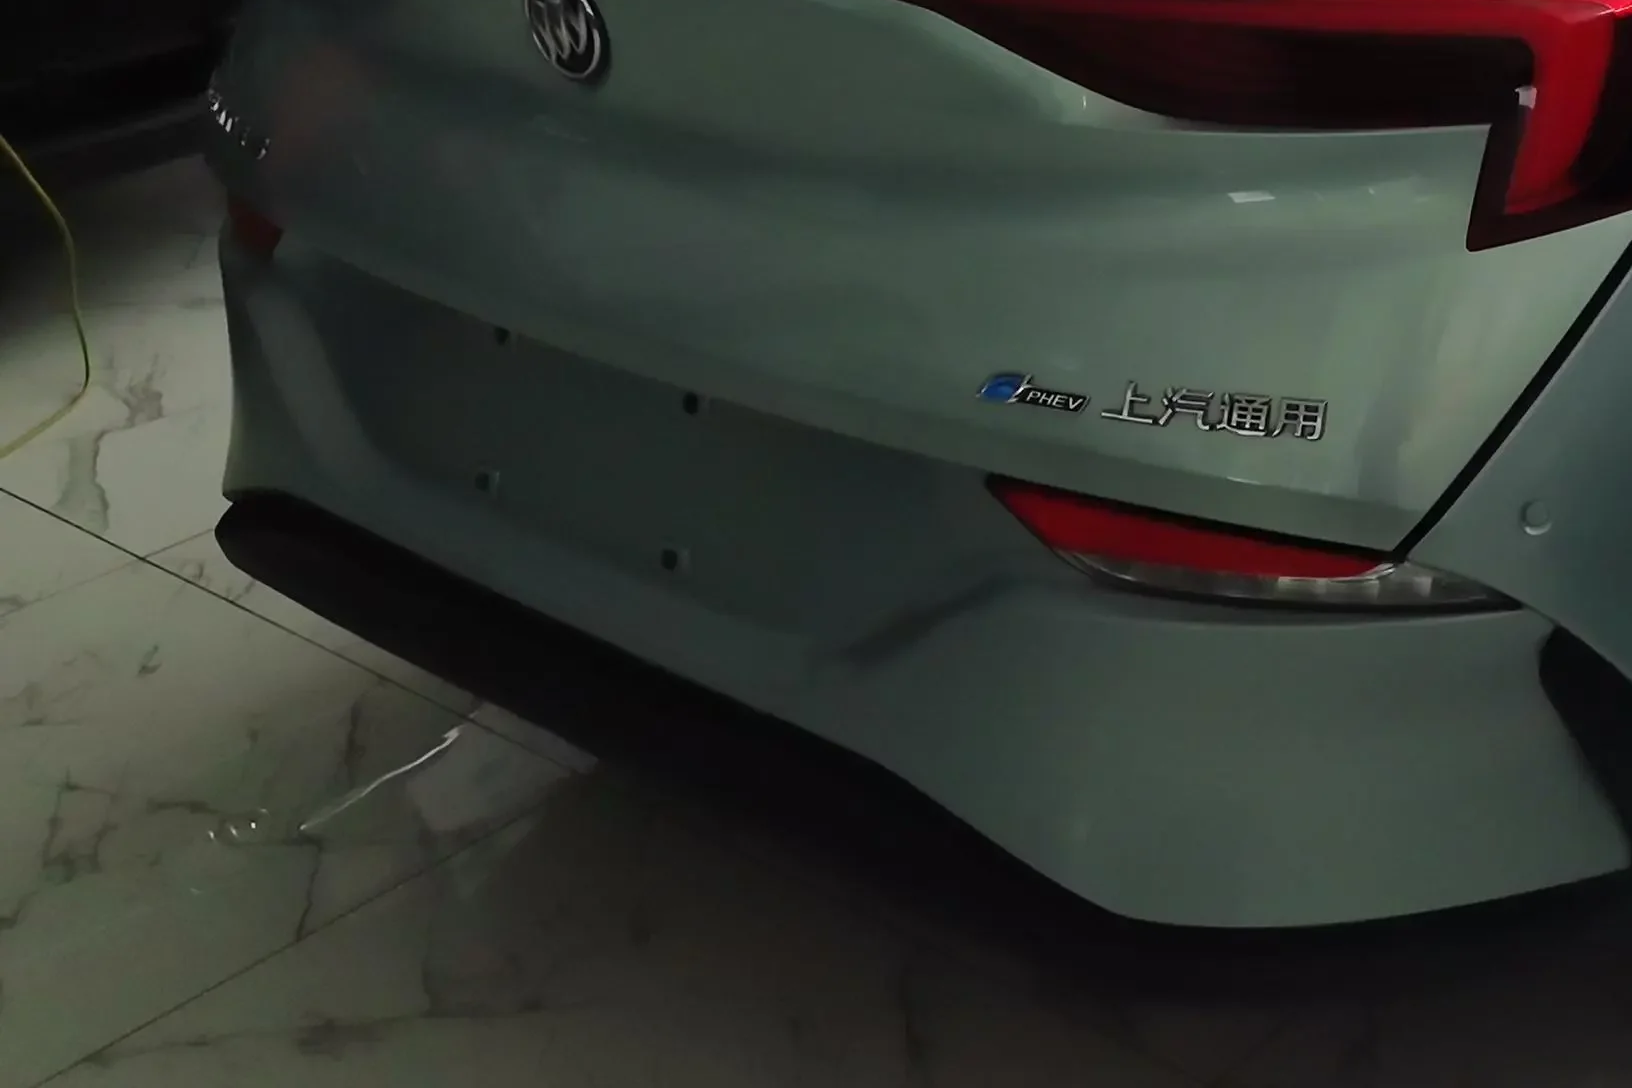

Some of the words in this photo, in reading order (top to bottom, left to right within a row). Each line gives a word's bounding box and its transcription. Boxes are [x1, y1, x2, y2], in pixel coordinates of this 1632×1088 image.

[1026, 390, 1083, 410] PHEV
[1100, 380, 1328, 441] 上汽通用
